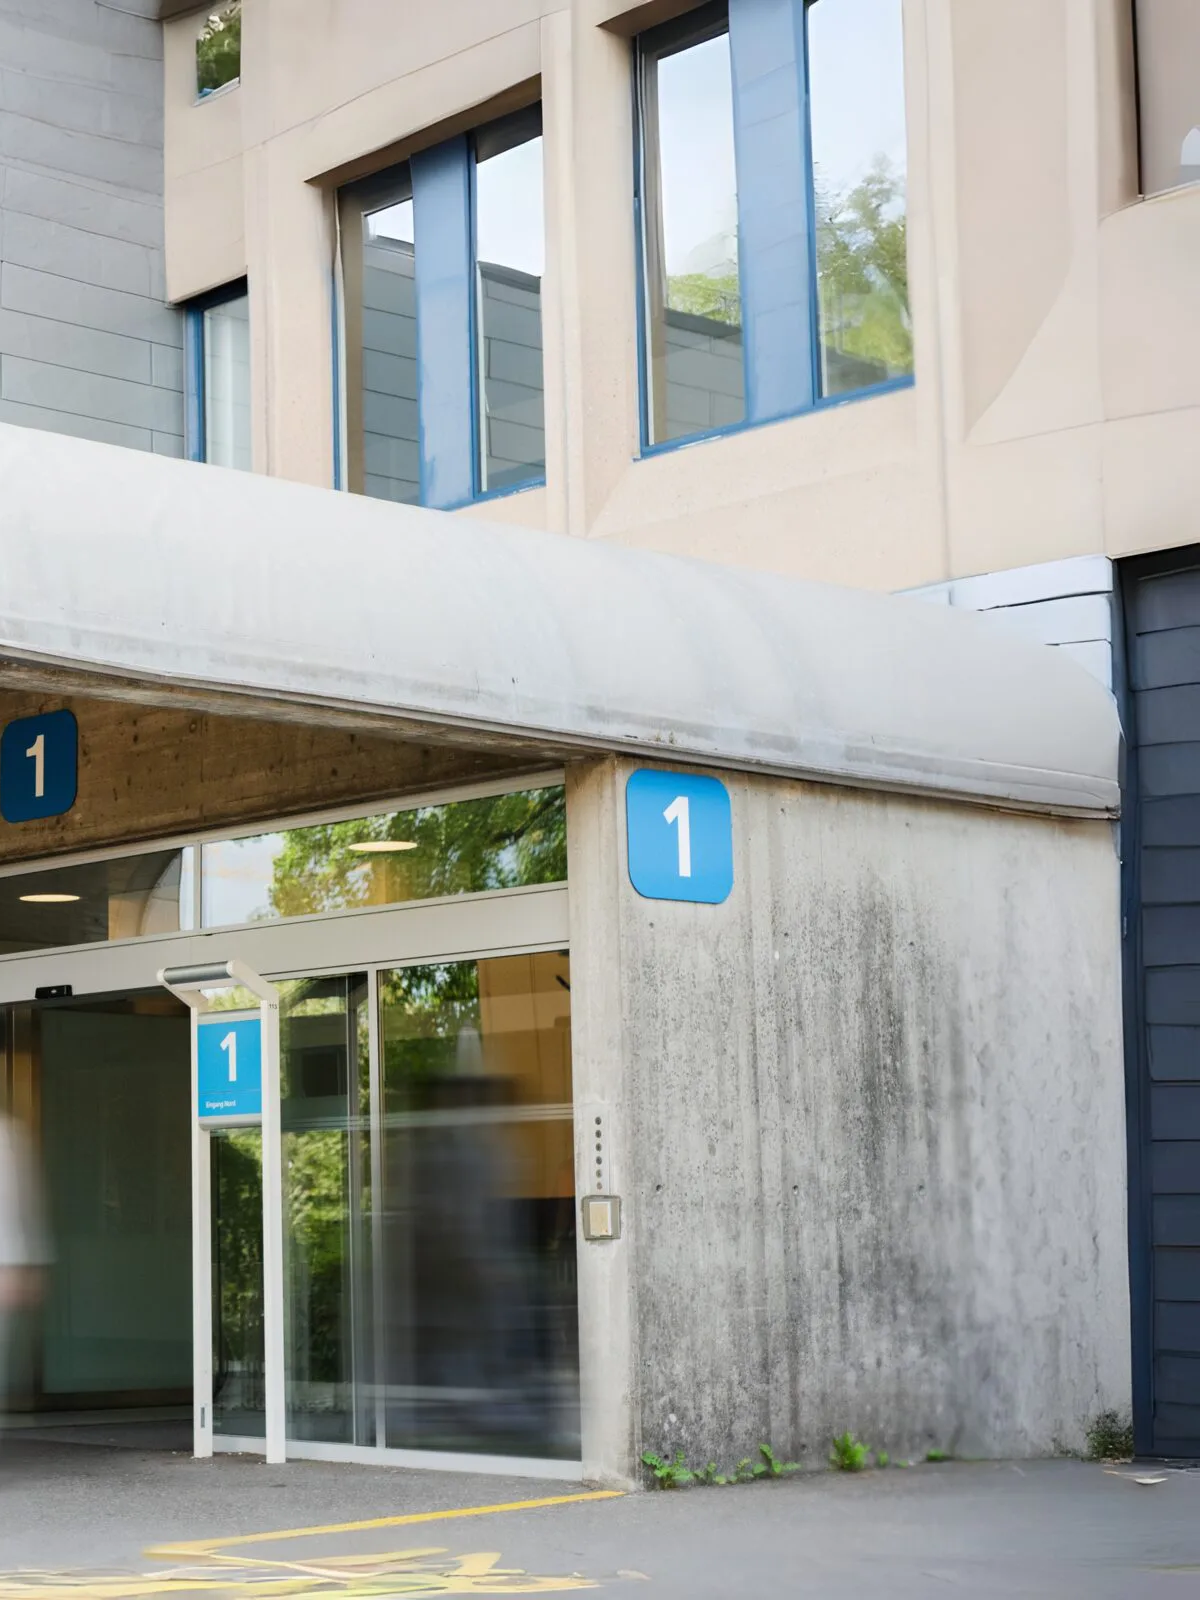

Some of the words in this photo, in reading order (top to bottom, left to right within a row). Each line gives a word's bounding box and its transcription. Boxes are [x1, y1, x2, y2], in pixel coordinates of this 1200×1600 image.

[26, 734, 45, 798] 1
[662, 795, 692, 878] 1
[220, 1031, 237, 1082] 1
